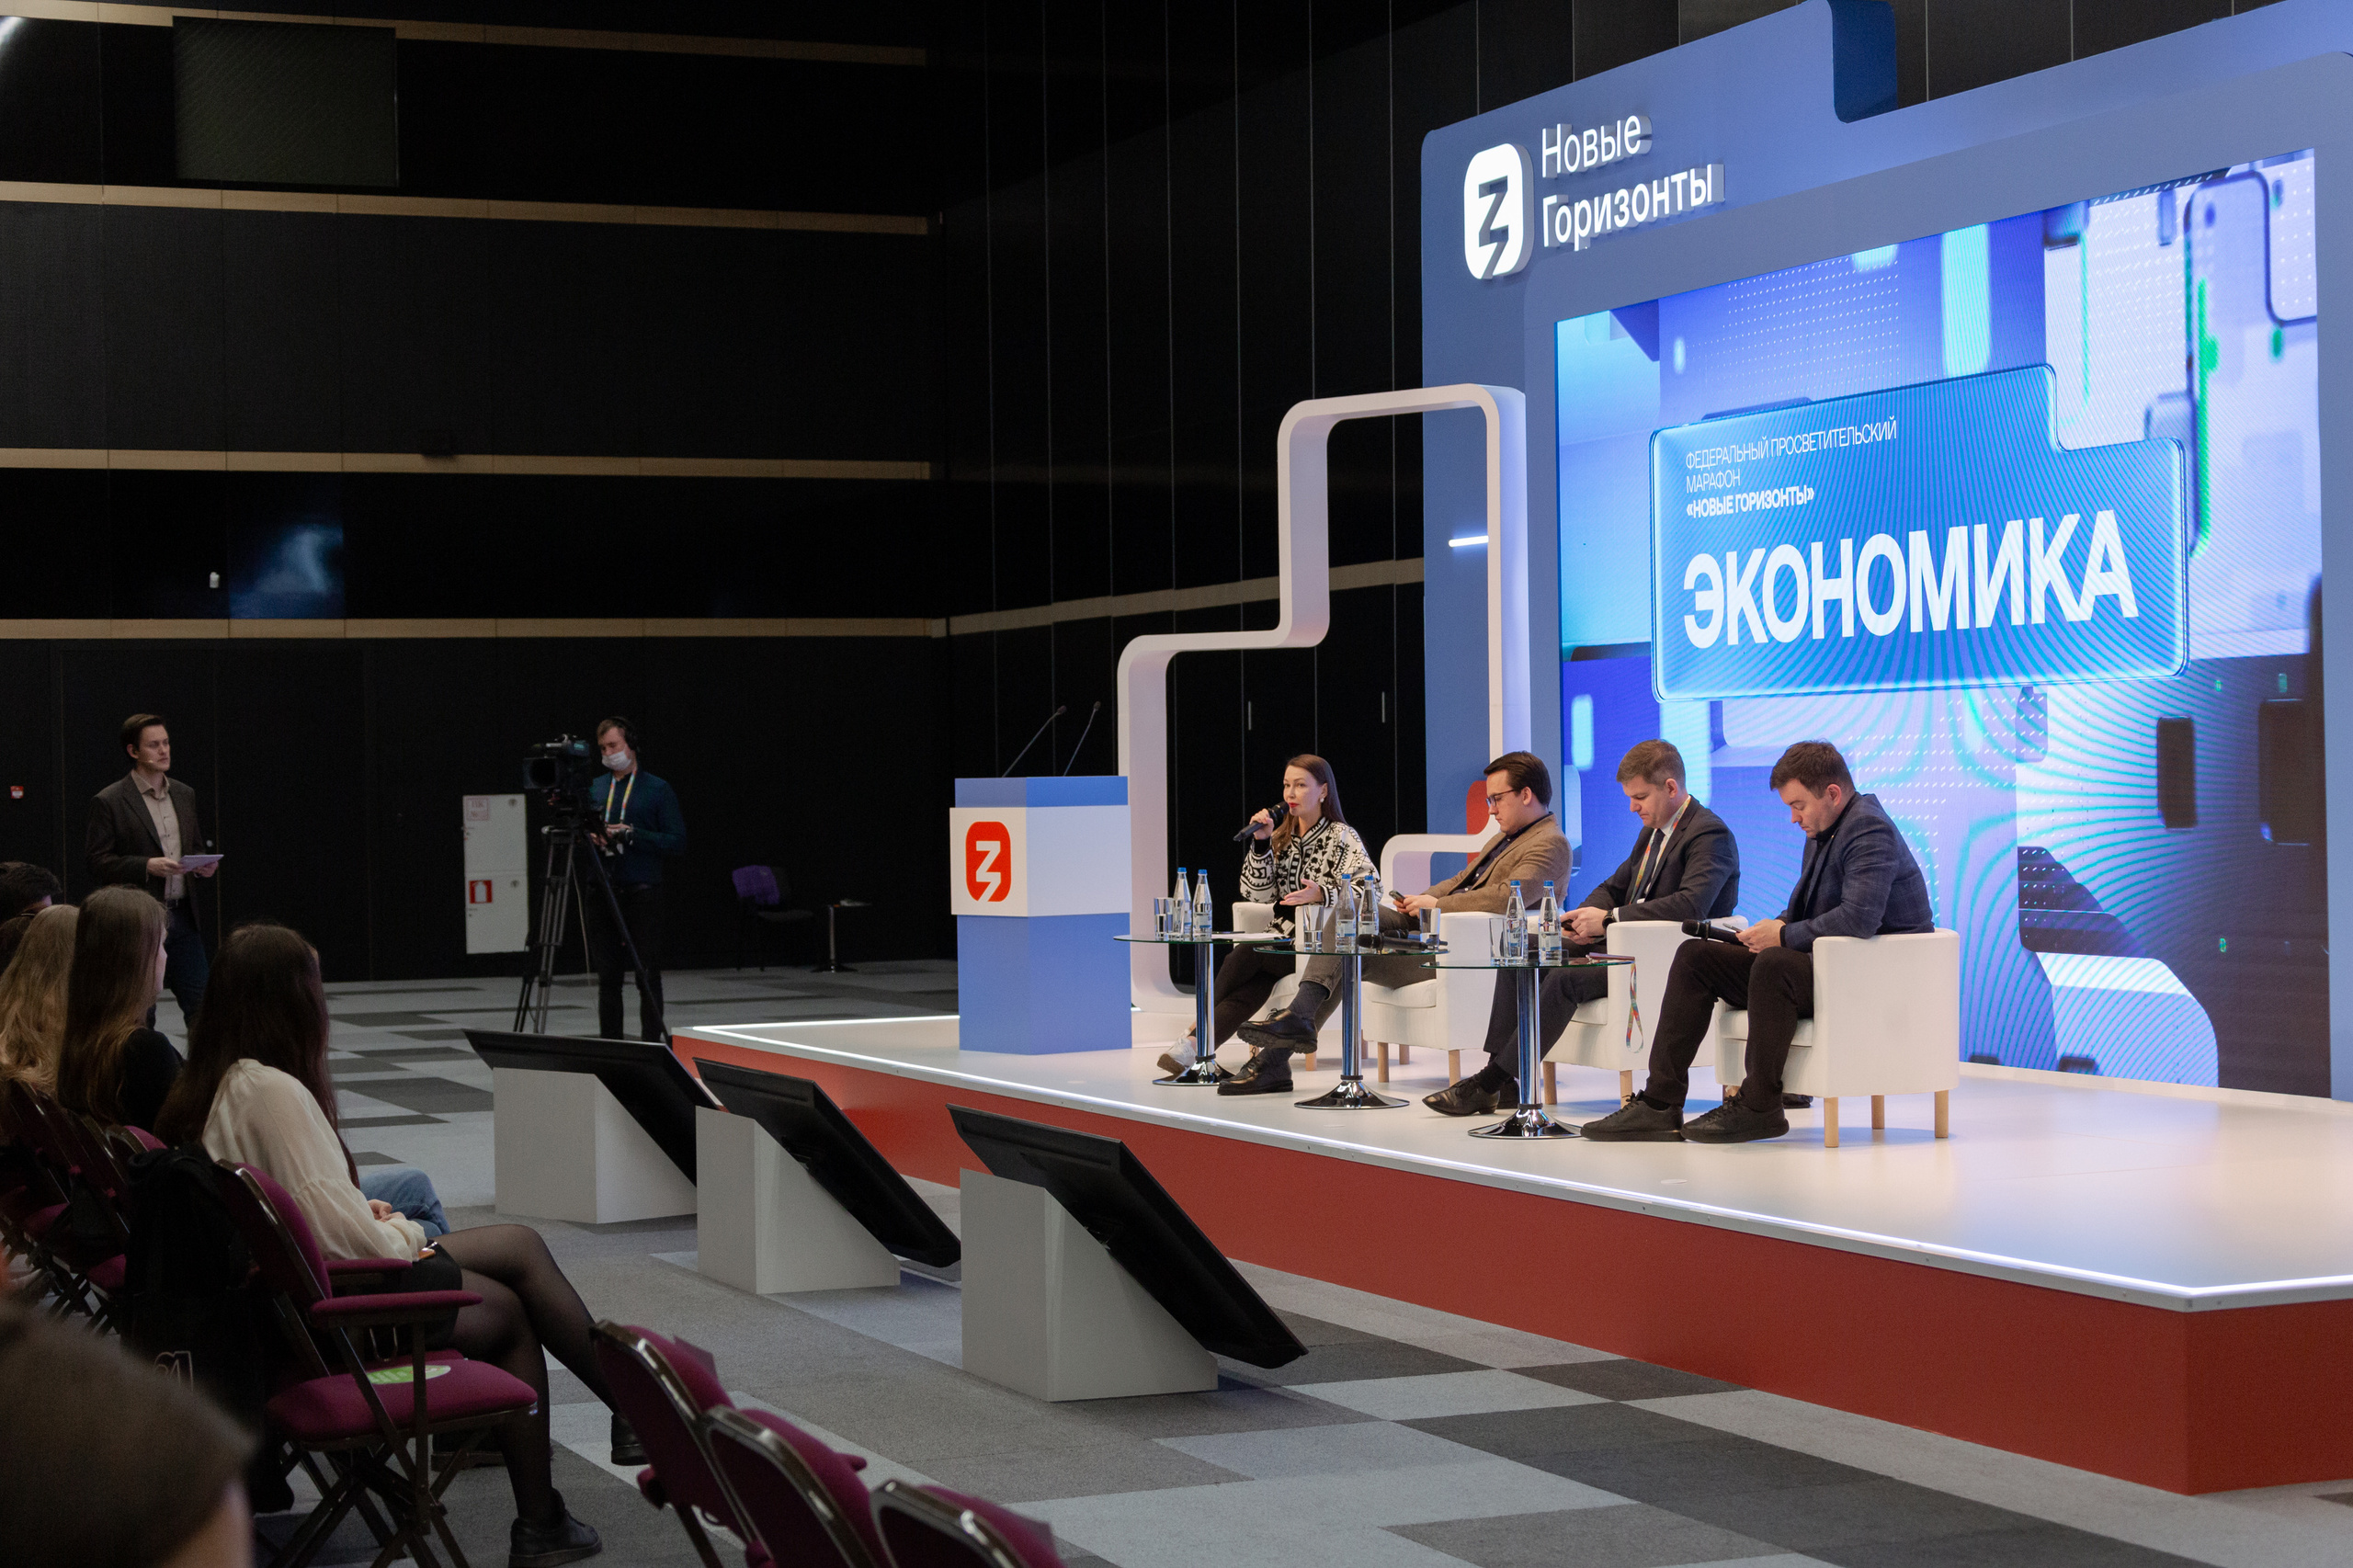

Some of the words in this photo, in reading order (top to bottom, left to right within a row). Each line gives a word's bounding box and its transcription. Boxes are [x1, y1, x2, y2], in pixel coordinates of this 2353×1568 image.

[1541, 115, 1643, 178] Новые
[1542, 164, 1715, 251] Горизонты
[1686, 436, 1769, 472] ФЕДЕРАЛЬНЫЙ
[1771, 415, 1897, 458] ПРОСВЕТИТЕЛЬСКИЙ
[1686, 469, 1741, 494] МАРАФОН
[1686, 492, 1734, 518] «НОВЫЕ
[1735, 484, 1815, 514] ГОРИЗОНТЫ»
[1683, 509, 2140, 649] ЭКОНОМИКА
